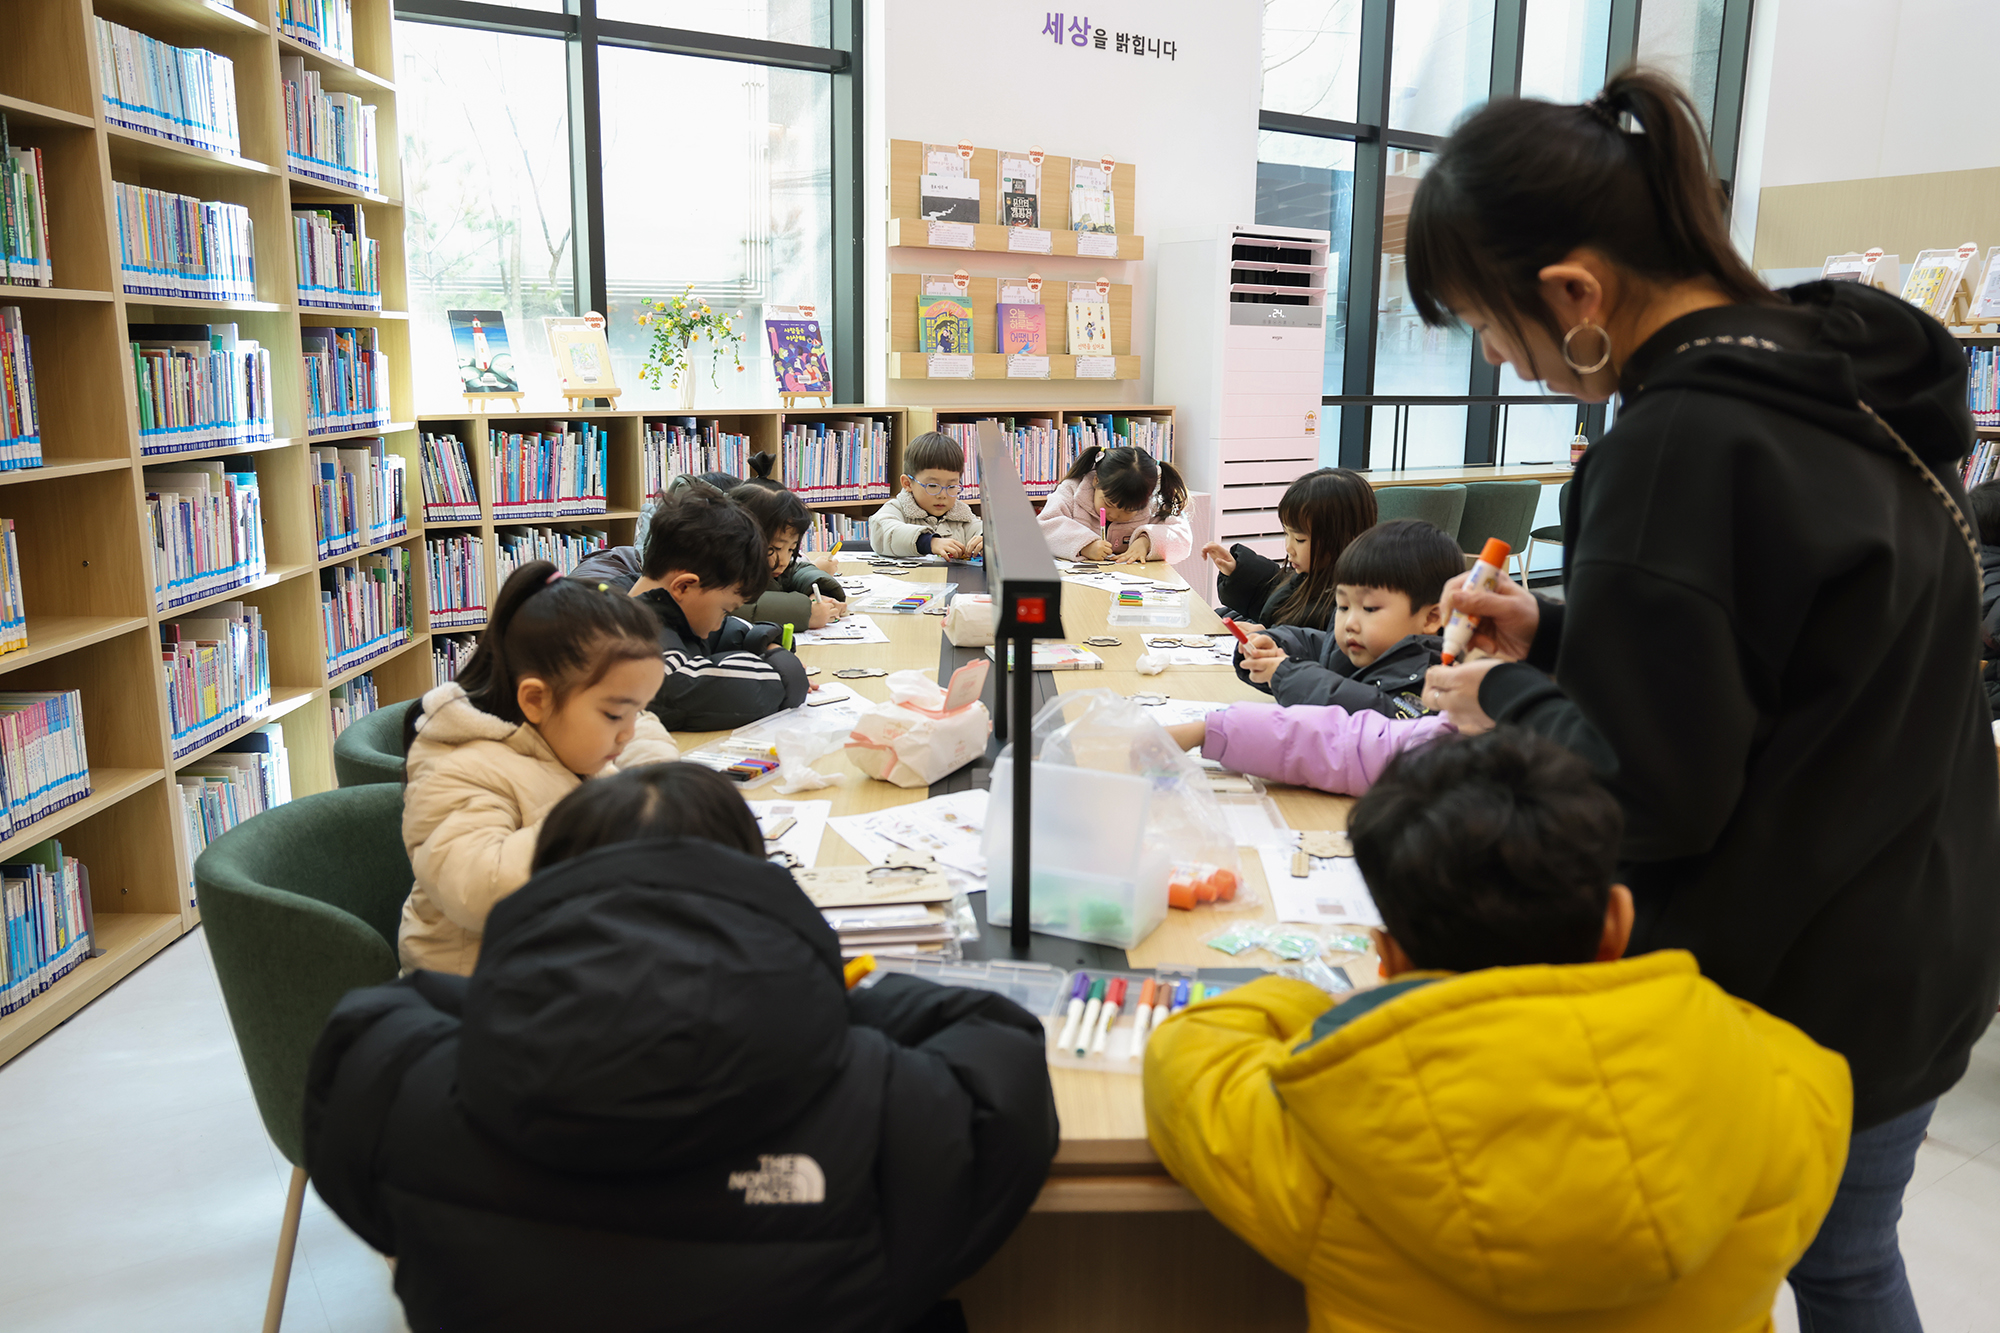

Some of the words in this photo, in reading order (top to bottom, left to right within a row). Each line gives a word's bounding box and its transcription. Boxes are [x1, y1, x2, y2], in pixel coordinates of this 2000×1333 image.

[1041, 12, 1108, 50] 세상을
[1116, 32, 1177, 61] 밝힙니다
[1009, 308, 1026, 320] 오늘
[1272, 308, 1283, 318] 24
[1009, 319, 1034, 331] 하루는
